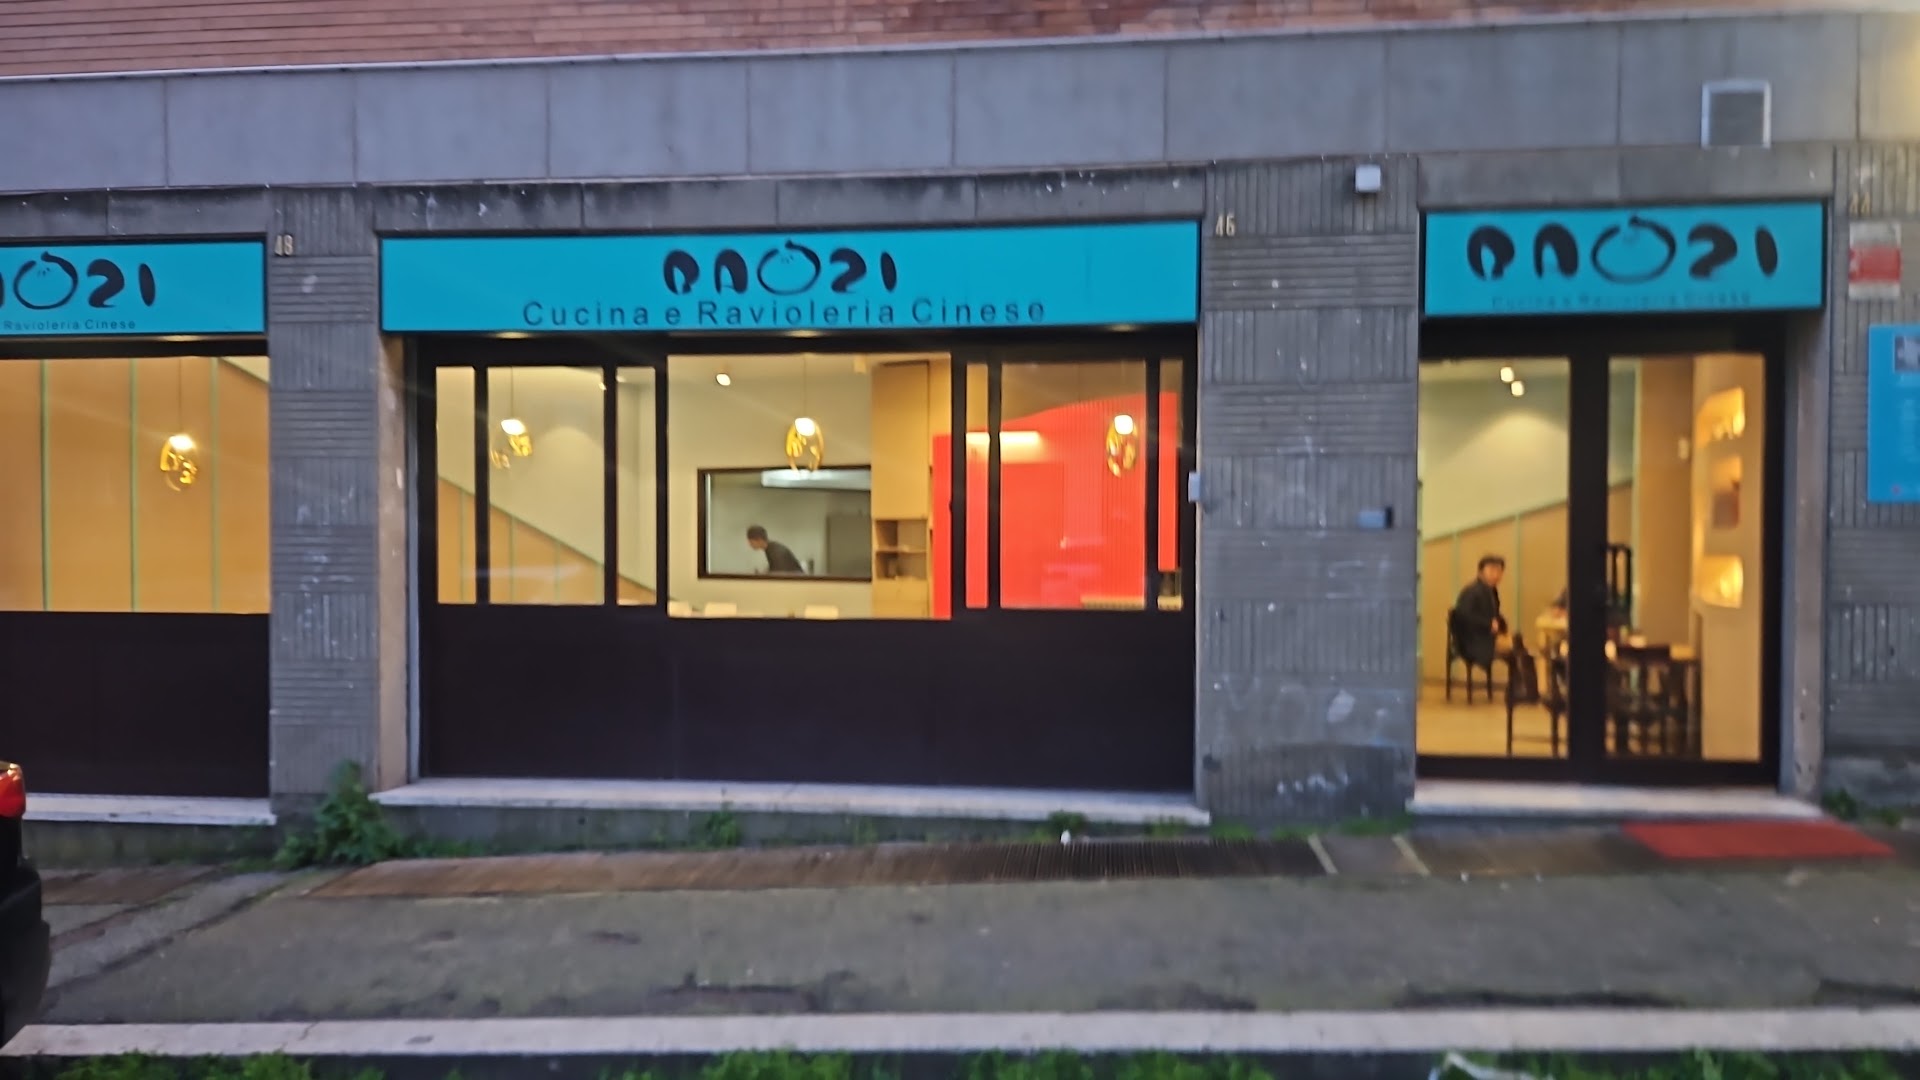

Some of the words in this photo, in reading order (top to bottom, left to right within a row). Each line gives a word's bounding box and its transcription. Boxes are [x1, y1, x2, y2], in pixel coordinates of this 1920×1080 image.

[1215, 213, 1235, 237] 46
[274, 234, 294, 257] 48
[523, 301, 649, 326] Cucina
[664, 307, 682, 325] e
[698, 299, 894, 325] Ravioleria
[911, 299, 1044, 324] Cinese
[3, 321, 80, 331] Ravioleria
[84, 319, 136, 331] Cinese
